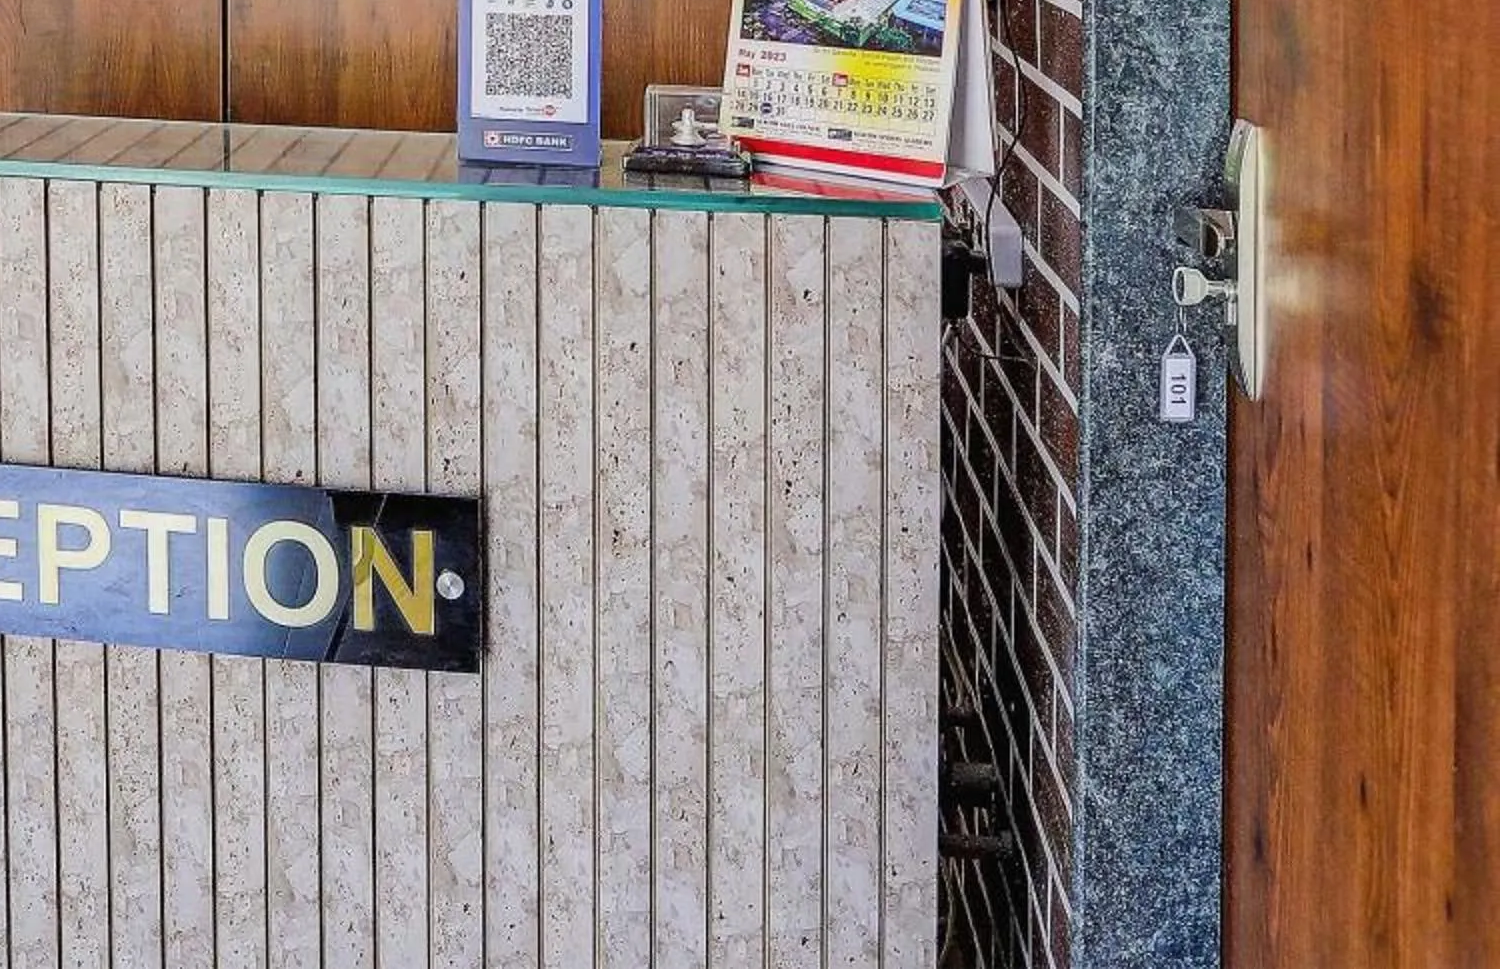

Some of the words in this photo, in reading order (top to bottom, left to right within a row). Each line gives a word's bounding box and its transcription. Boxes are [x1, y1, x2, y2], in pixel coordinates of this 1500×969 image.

[760, 50, 787, 62] 2023
[503, 135, 532, 145] HDFC
[535, 136, 567, 146] BANK
[1171, 374, 1187, 406] 101
